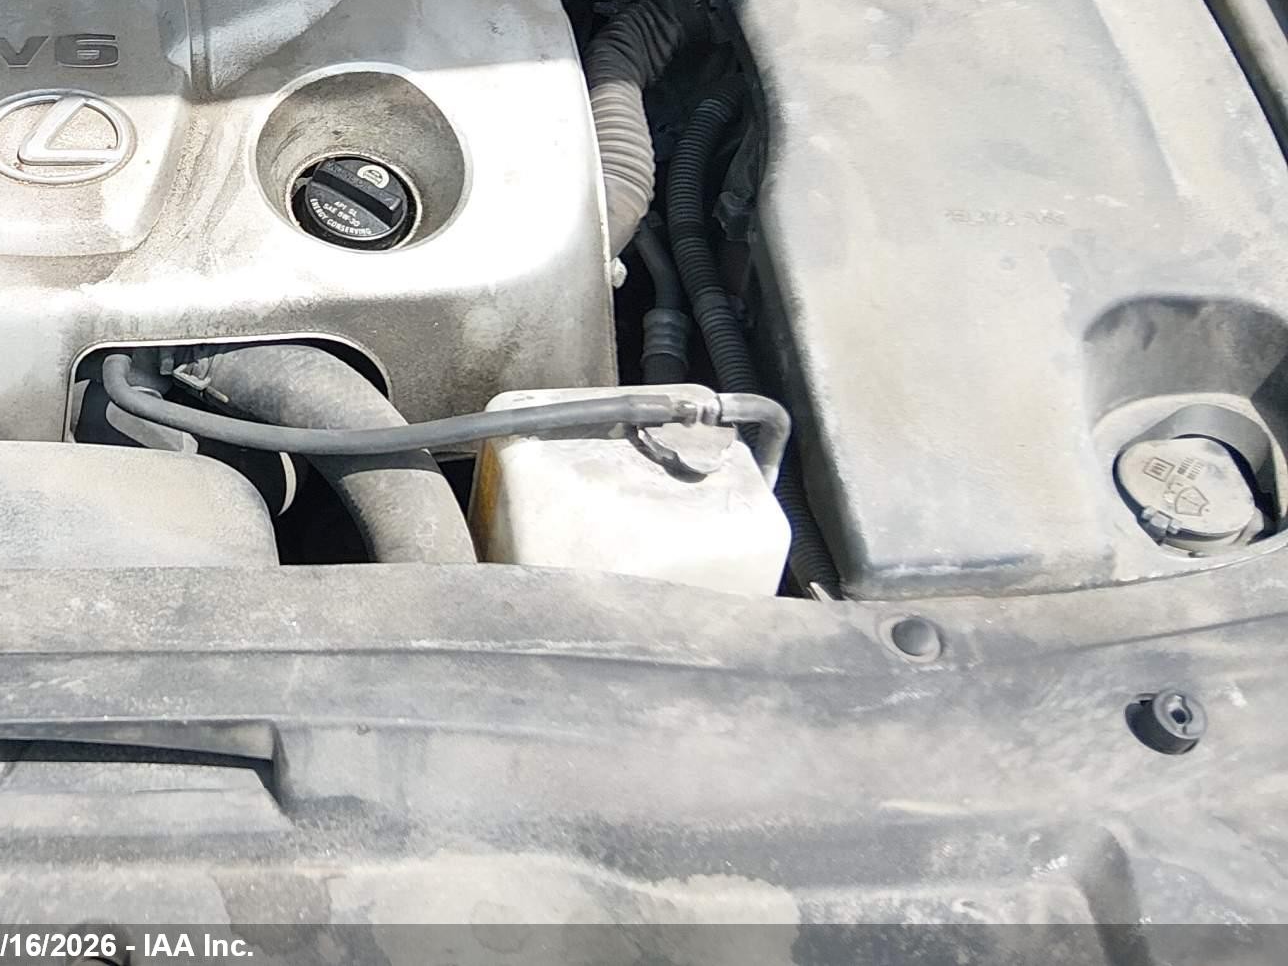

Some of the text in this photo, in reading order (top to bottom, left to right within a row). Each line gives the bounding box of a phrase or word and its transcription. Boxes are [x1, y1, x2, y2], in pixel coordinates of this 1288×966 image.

[310, 198, 372, 235] ENERGY CONSERVING
[322, 203, 361, 227] SAE 5W-30
[334, 201, 358, 218] API SL
